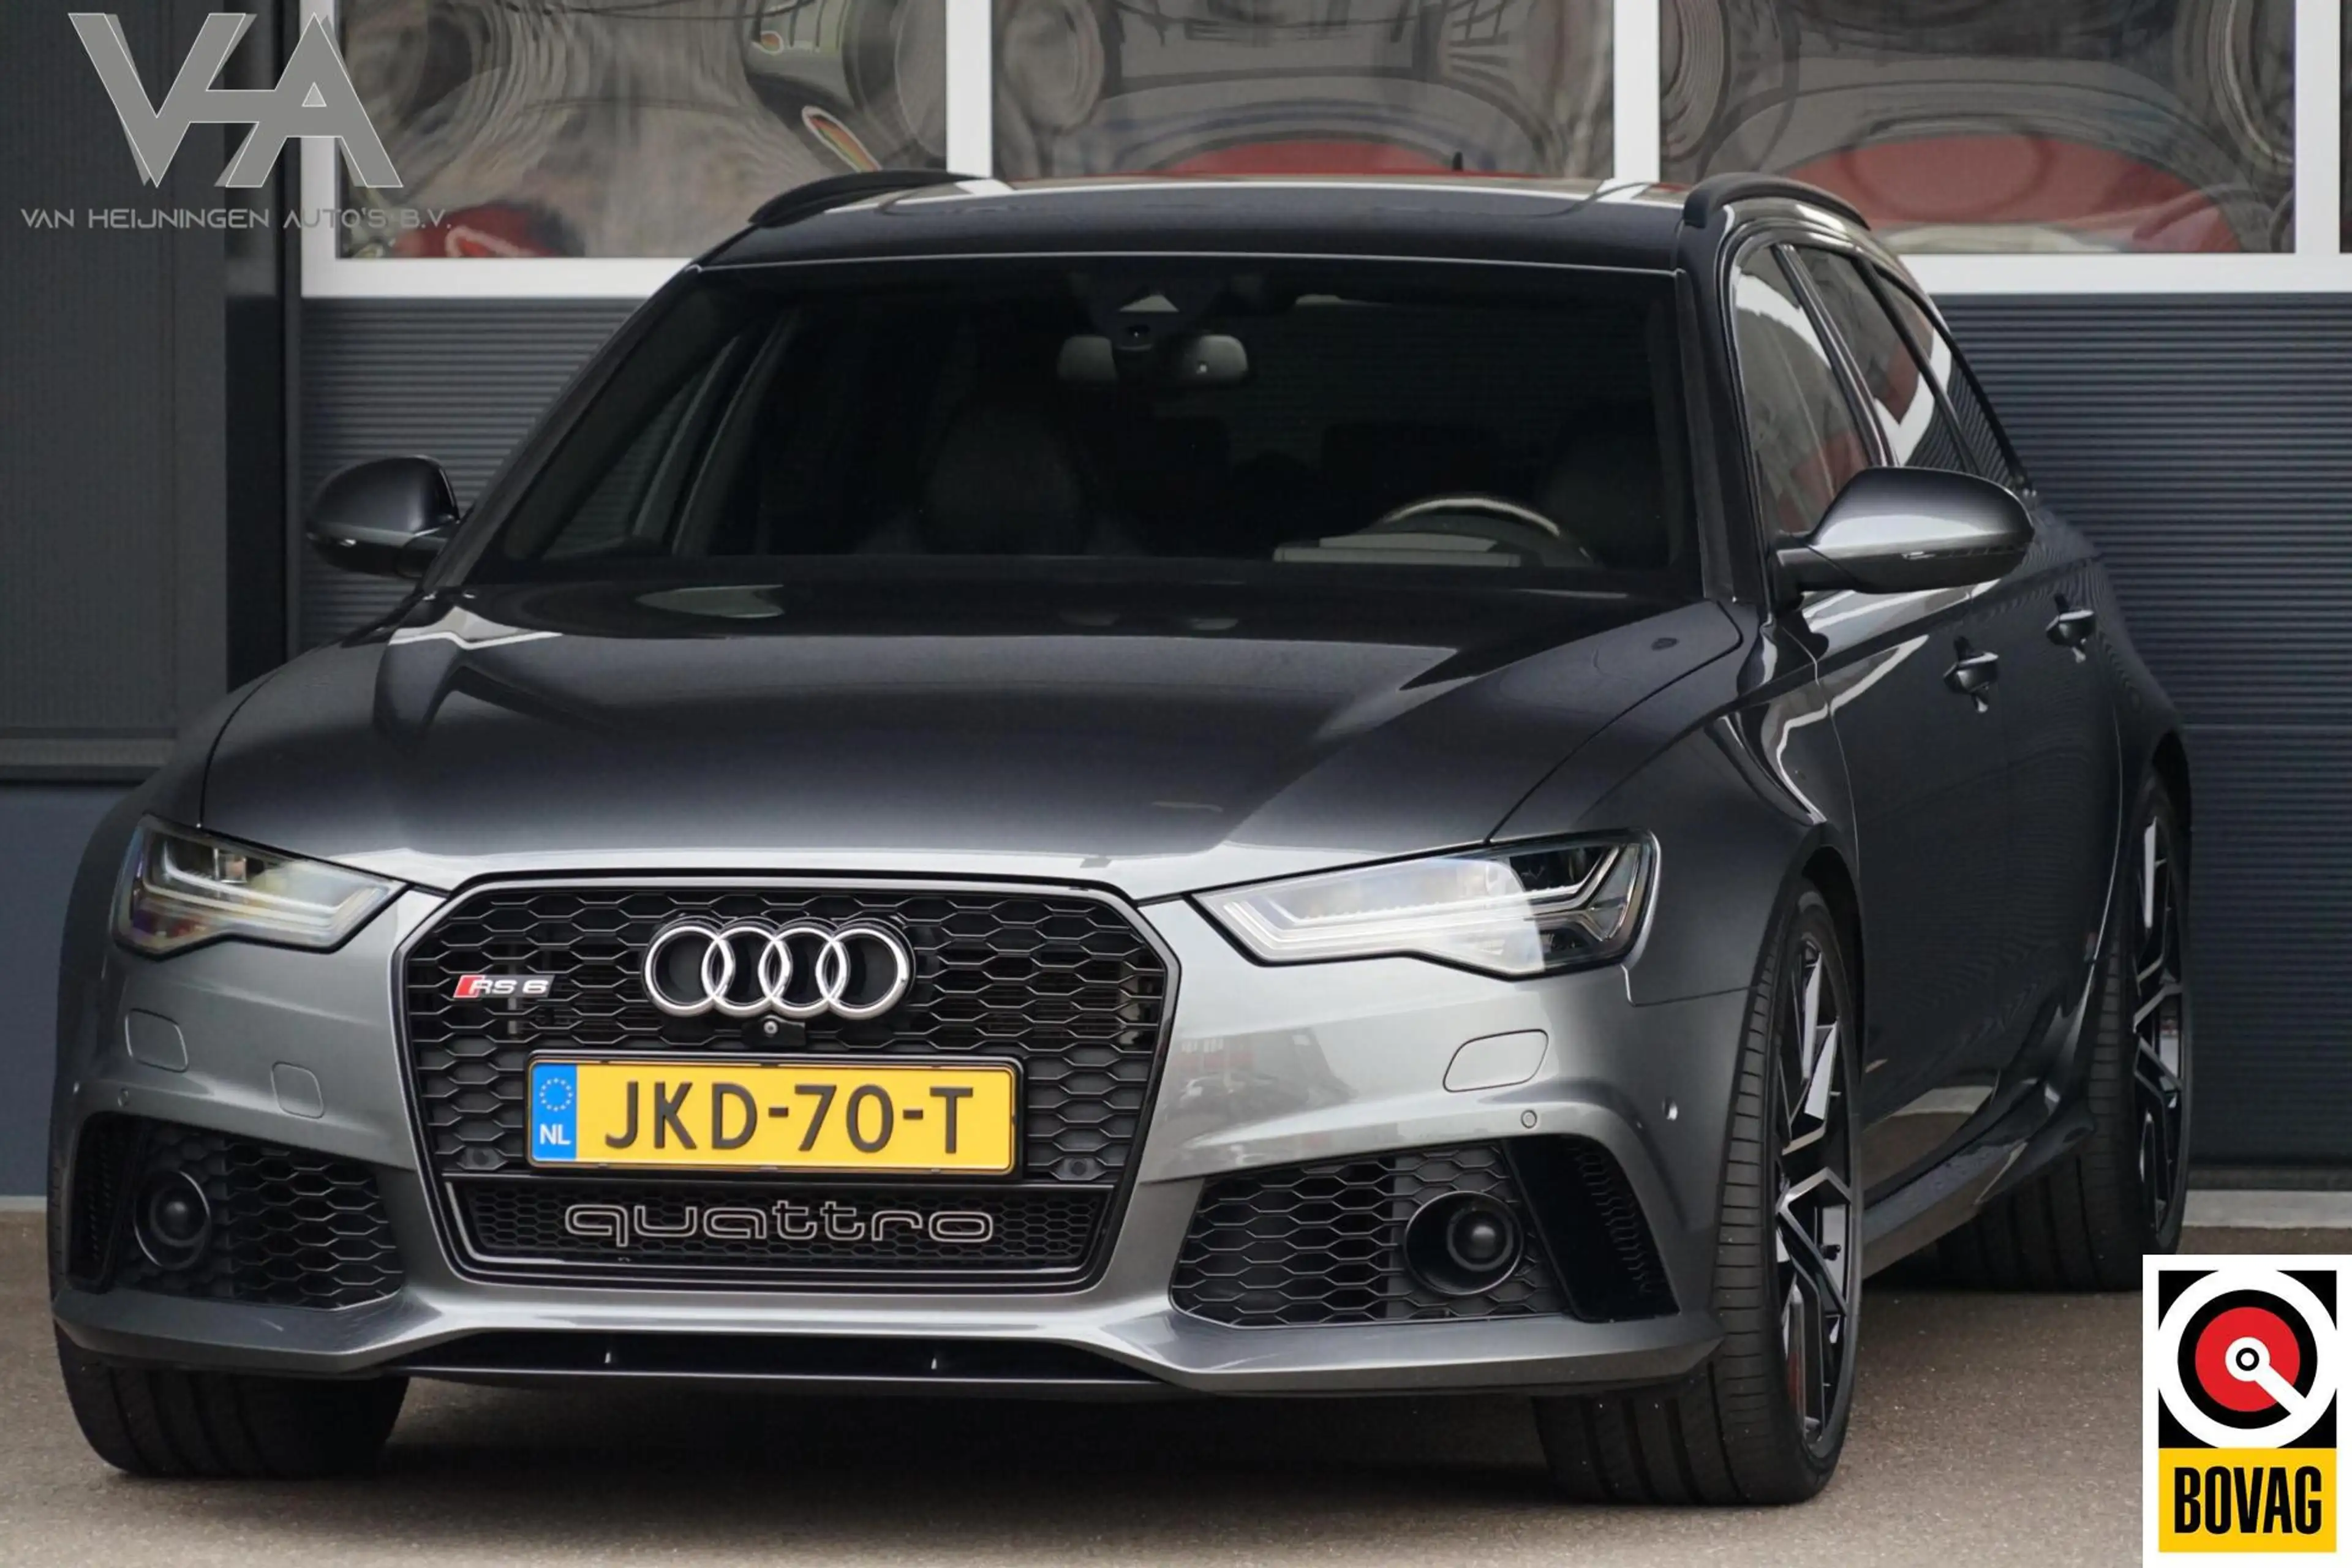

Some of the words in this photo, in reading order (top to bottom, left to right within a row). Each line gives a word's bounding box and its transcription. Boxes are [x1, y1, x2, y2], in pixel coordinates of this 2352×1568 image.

[539, 1123, 571, 1145] NL
[605, 1080, 974, 1154] JKD-70-T
[564, 1200, 993, 1248] quattro
